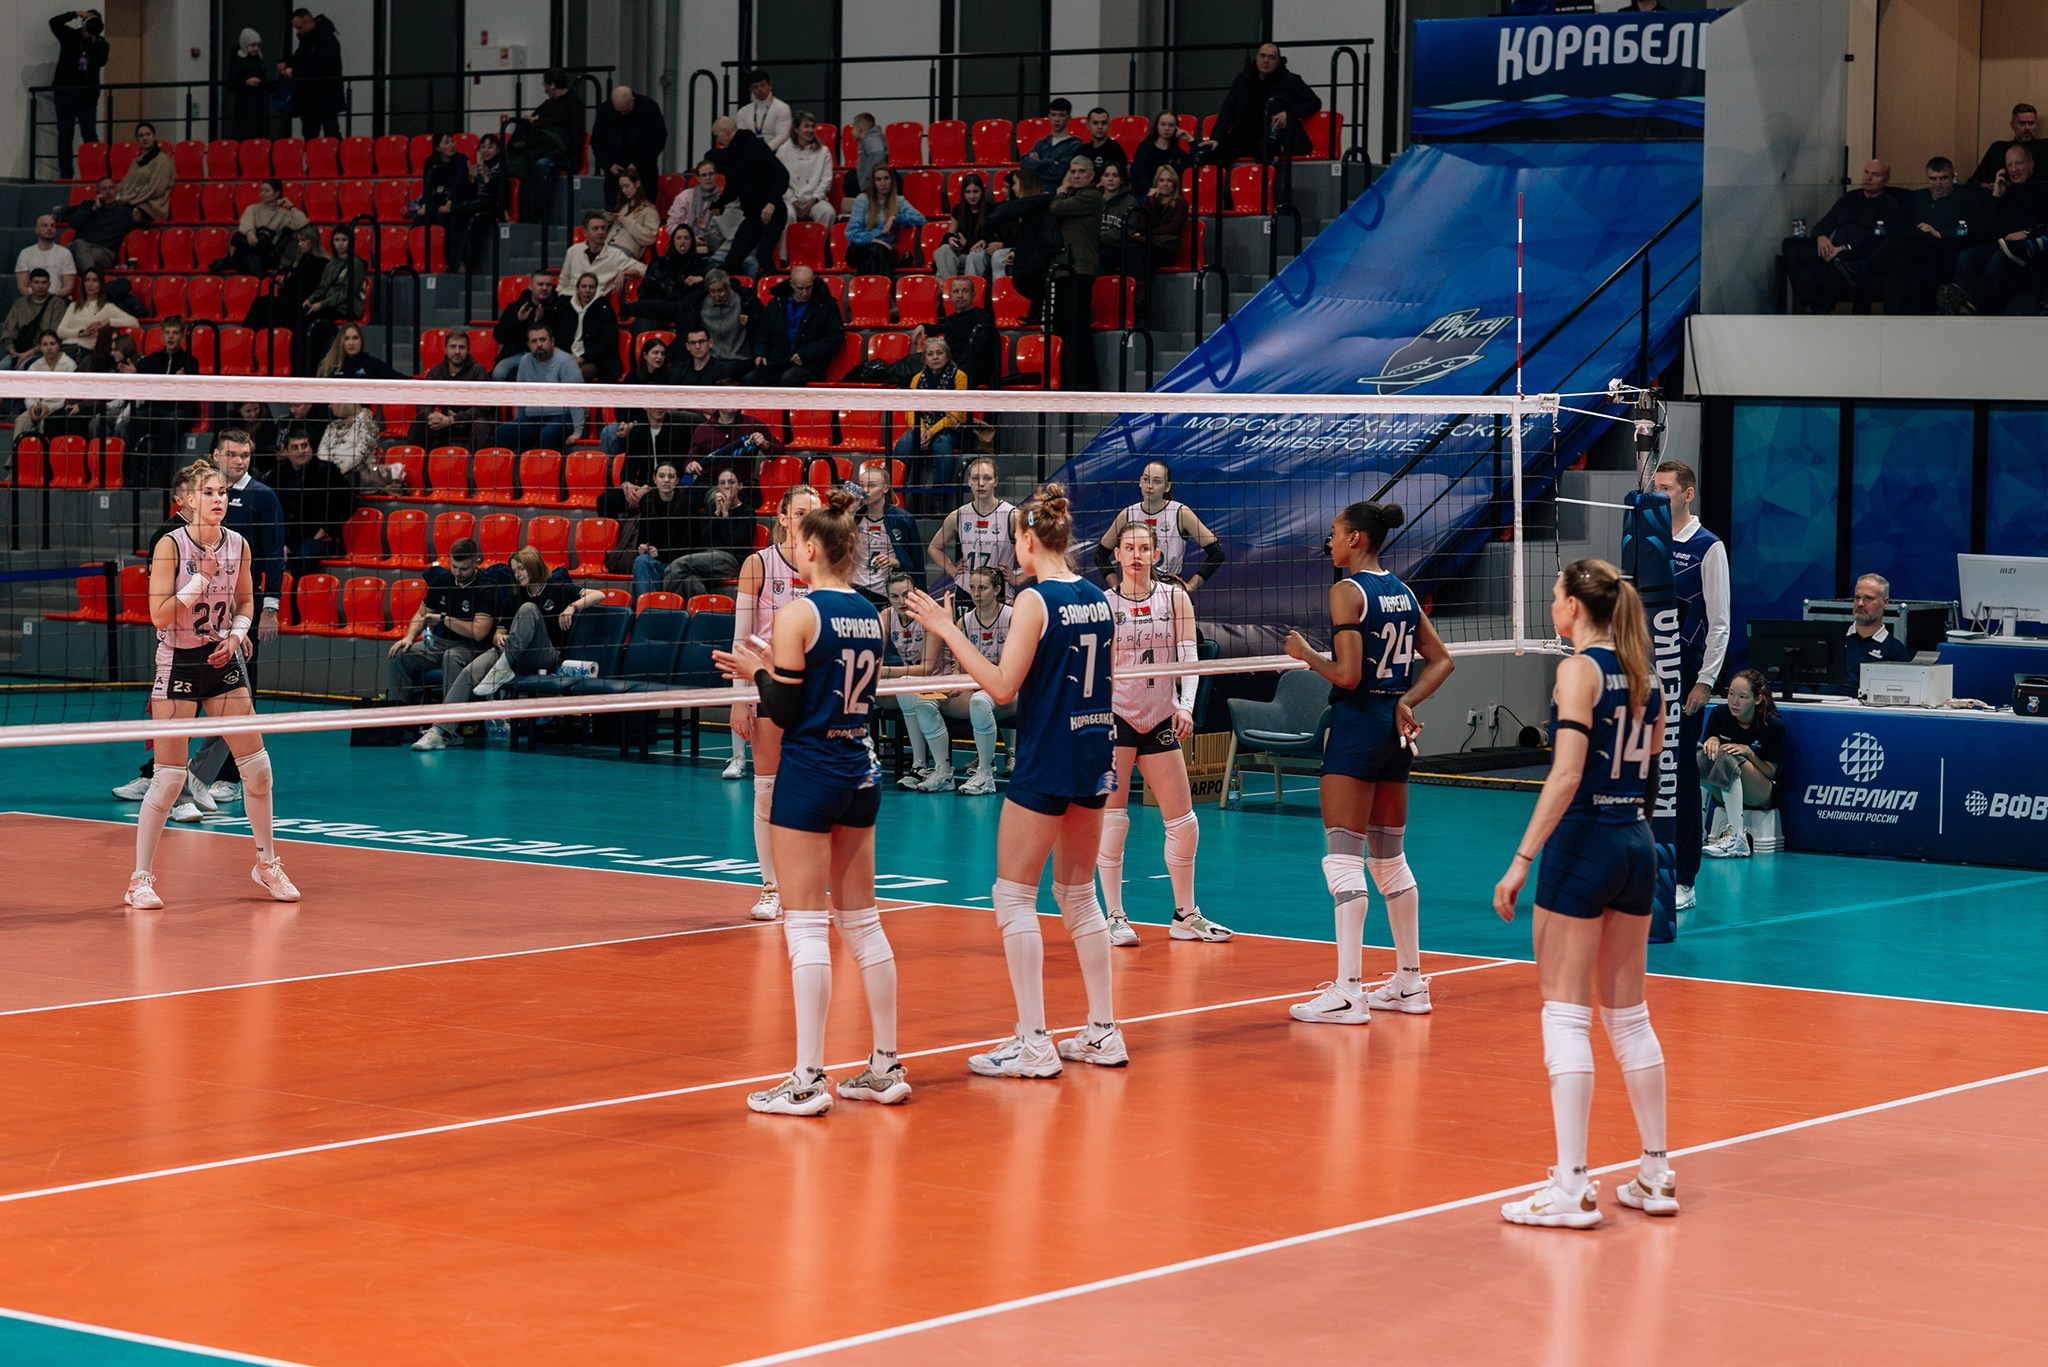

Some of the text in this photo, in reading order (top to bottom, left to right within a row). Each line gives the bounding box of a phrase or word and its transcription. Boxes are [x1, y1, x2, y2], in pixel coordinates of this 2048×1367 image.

[1183, 416, 1324, 432] МОРСКОЙ
[1376, 621, 1413, 679] 24
[1080, 633, 1097, 698] 7
[173, 680, 192, 694] 23
[841, 648, 875, 714] 12
[1652, 607, 1682, 818] КОРАБЕЛКА
[1610, 704, 1653, 779] 14
[1191, 779, 1223, 797] ARPO
[1803, 784, 1919, 811] СУПЕРЛИГА
[1816, 809, 1899, 824] ЧЕМПИОНАТ РОССИИ
[1989, 792, 2048, 821] ВФВ
